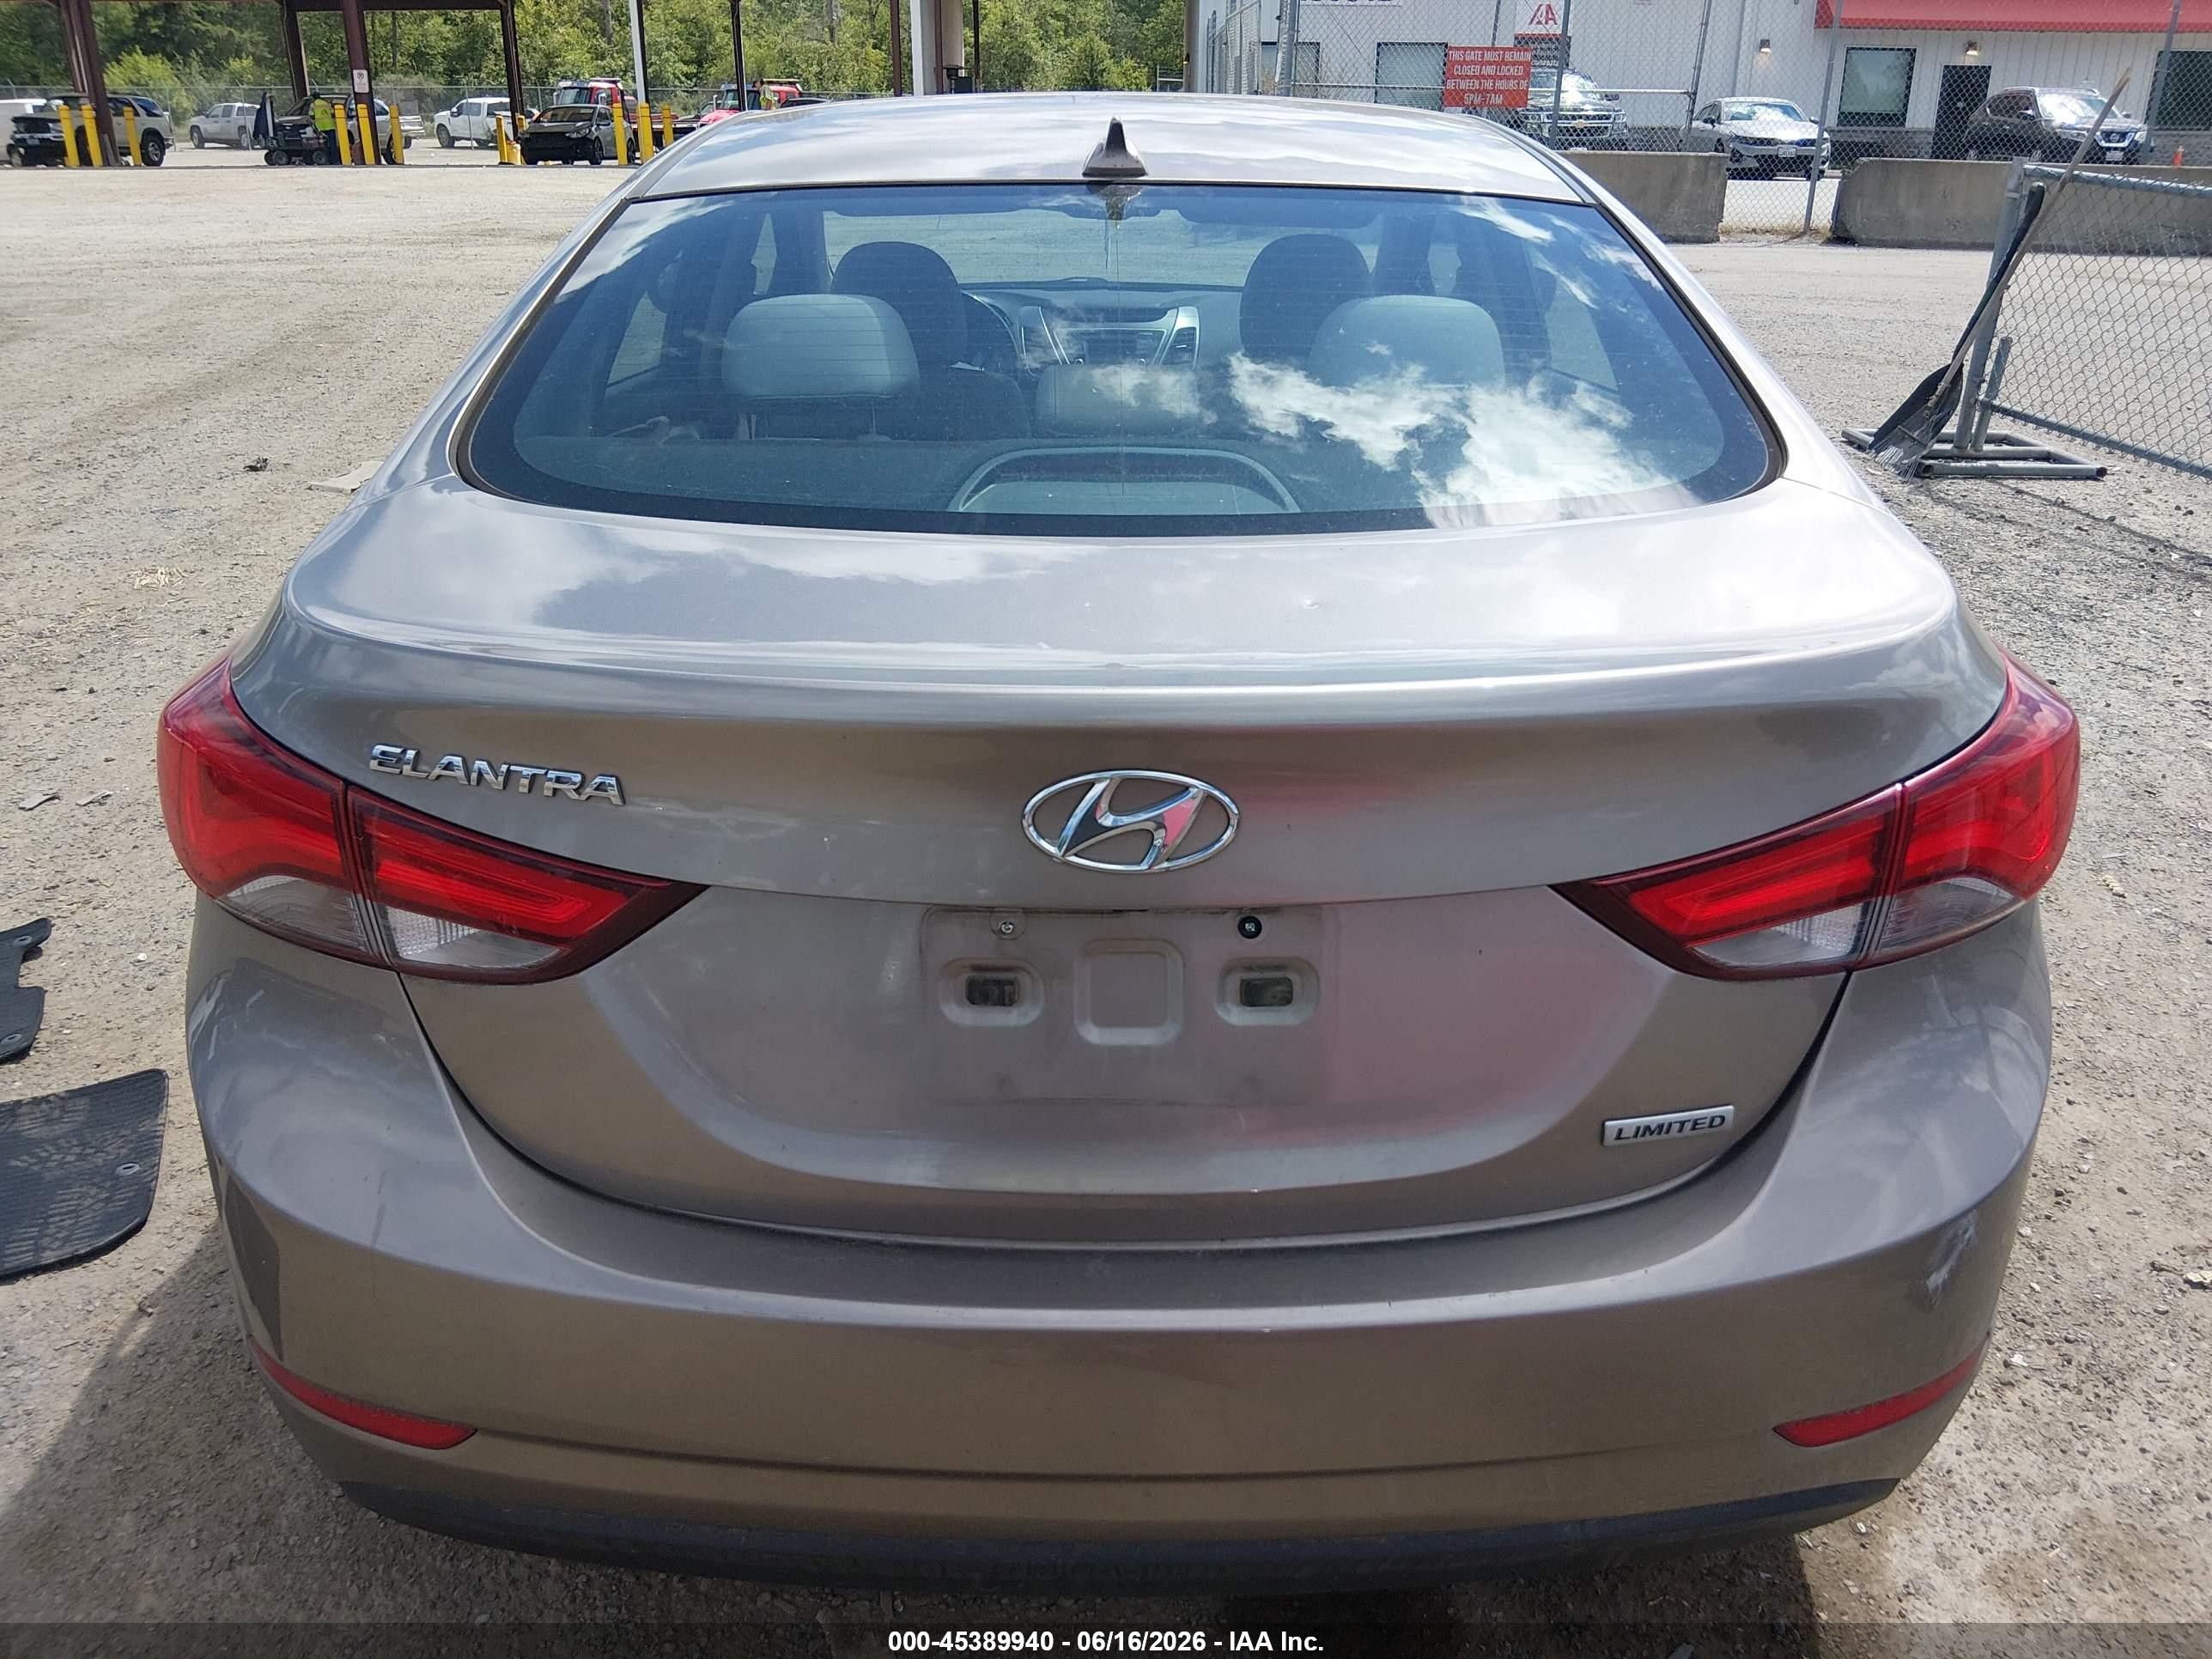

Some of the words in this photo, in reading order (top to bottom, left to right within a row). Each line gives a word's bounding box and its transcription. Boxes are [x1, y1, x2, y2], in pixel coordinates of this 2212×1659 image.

[1449, 51, 1464, 61] THIS
[1465, 51, 1482, 61] GATE
[1484, 51, 1504, 61] MUST
[1504, 51, 1531, 62] REMAIN
[1454, 65, 1480, 76] CLOSED
[1480, 65, 1496, 76] AND
[1497, 65, 1524, 76] LOCKED
[1446, 79, 1480, 90] BETWEEN
[1480, 79, 1494, 90] THE
[1495, 79, 1518, 90] HOURS
[1519, 79, 1528, 90] OF
[369, 744, 626, 805] ELANTRA
[1613, 1115, 1726, 1141] LIMITED
